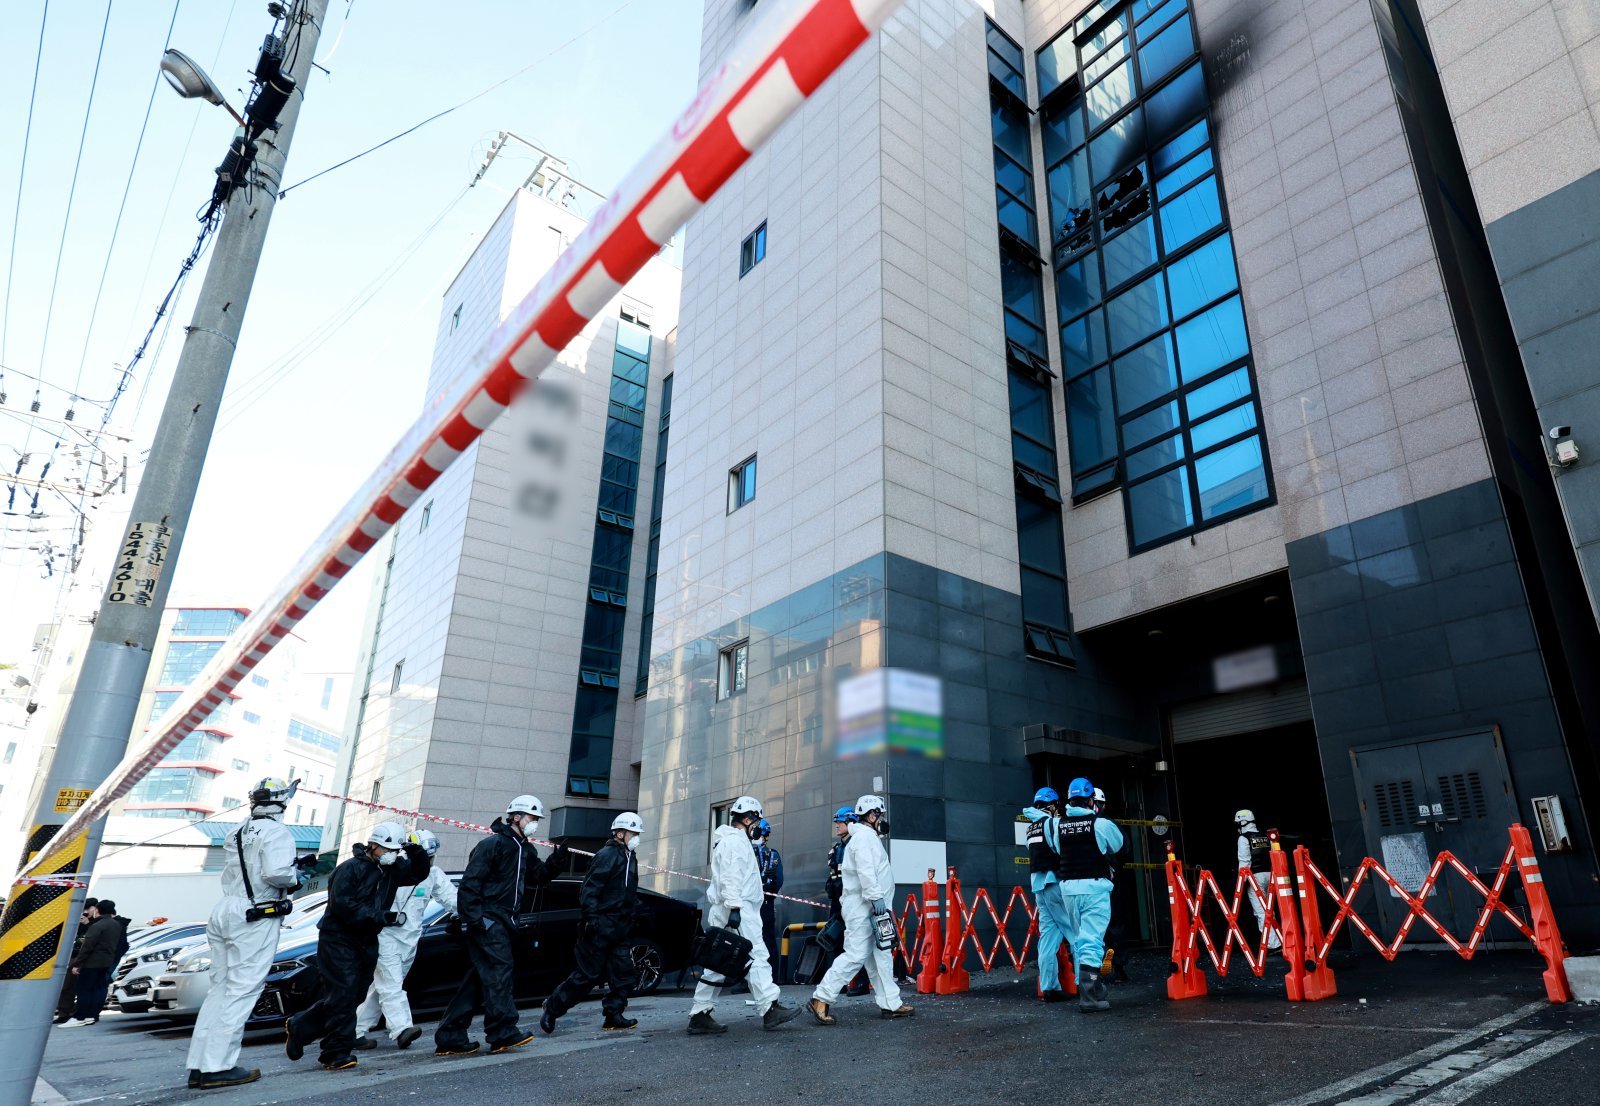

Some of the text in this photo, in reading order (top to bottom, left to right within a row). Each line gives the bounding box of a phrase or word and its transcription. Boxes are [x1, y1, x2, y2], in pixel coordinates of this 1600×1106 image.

[141, 526, 171, 566] 부동산
[130, 578, 156, 606] 대출
[1061, 826, 1091, 834] 사고조사
